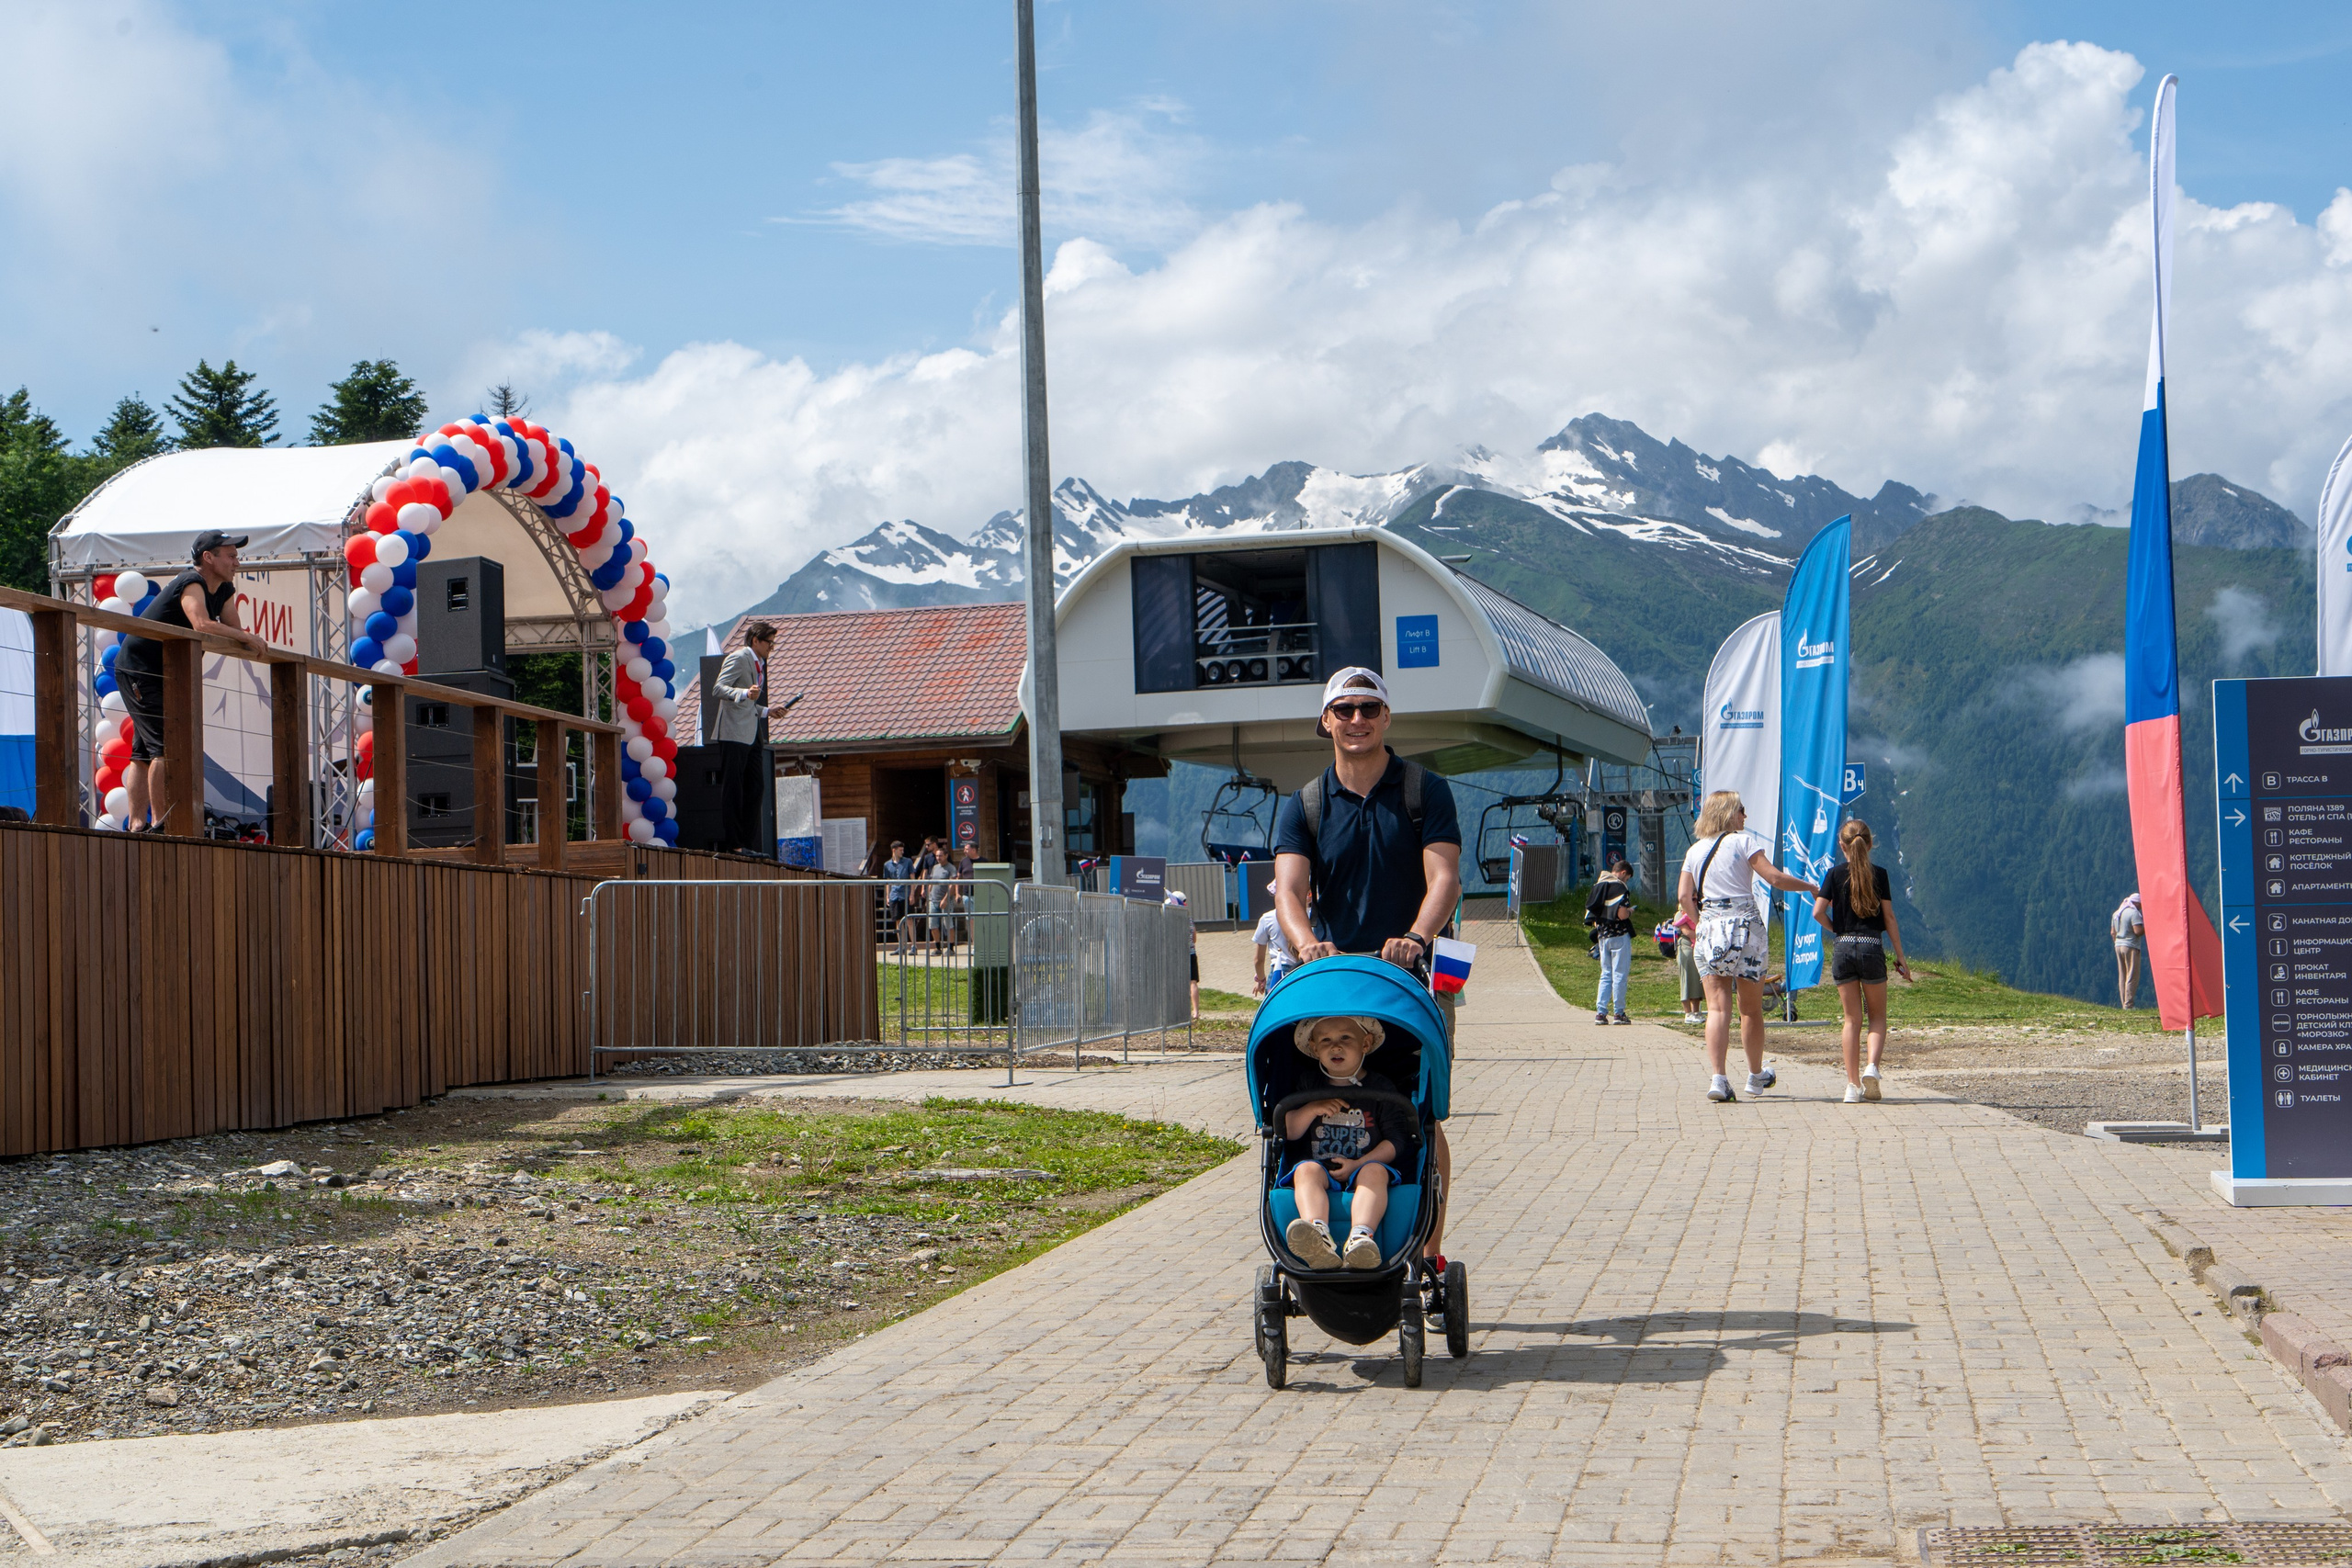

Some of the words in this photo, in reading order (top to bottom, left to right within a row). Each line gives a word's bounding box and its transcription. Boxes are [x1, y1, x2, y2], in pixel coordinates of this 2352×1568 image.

[1405, 630, 1423, 638] Лифт
[1645, 842, 1655, 852] 10
[2290, 852, 2352, 861] КОТТЕДЖНЫЙ
[2290, 862, 2333, 870] ПОСЁЛОК
[2293, 947, 2321, 955] ЦЕНТР
[2297, 1021, 2336, 1030] ДЕТСКИЙ
